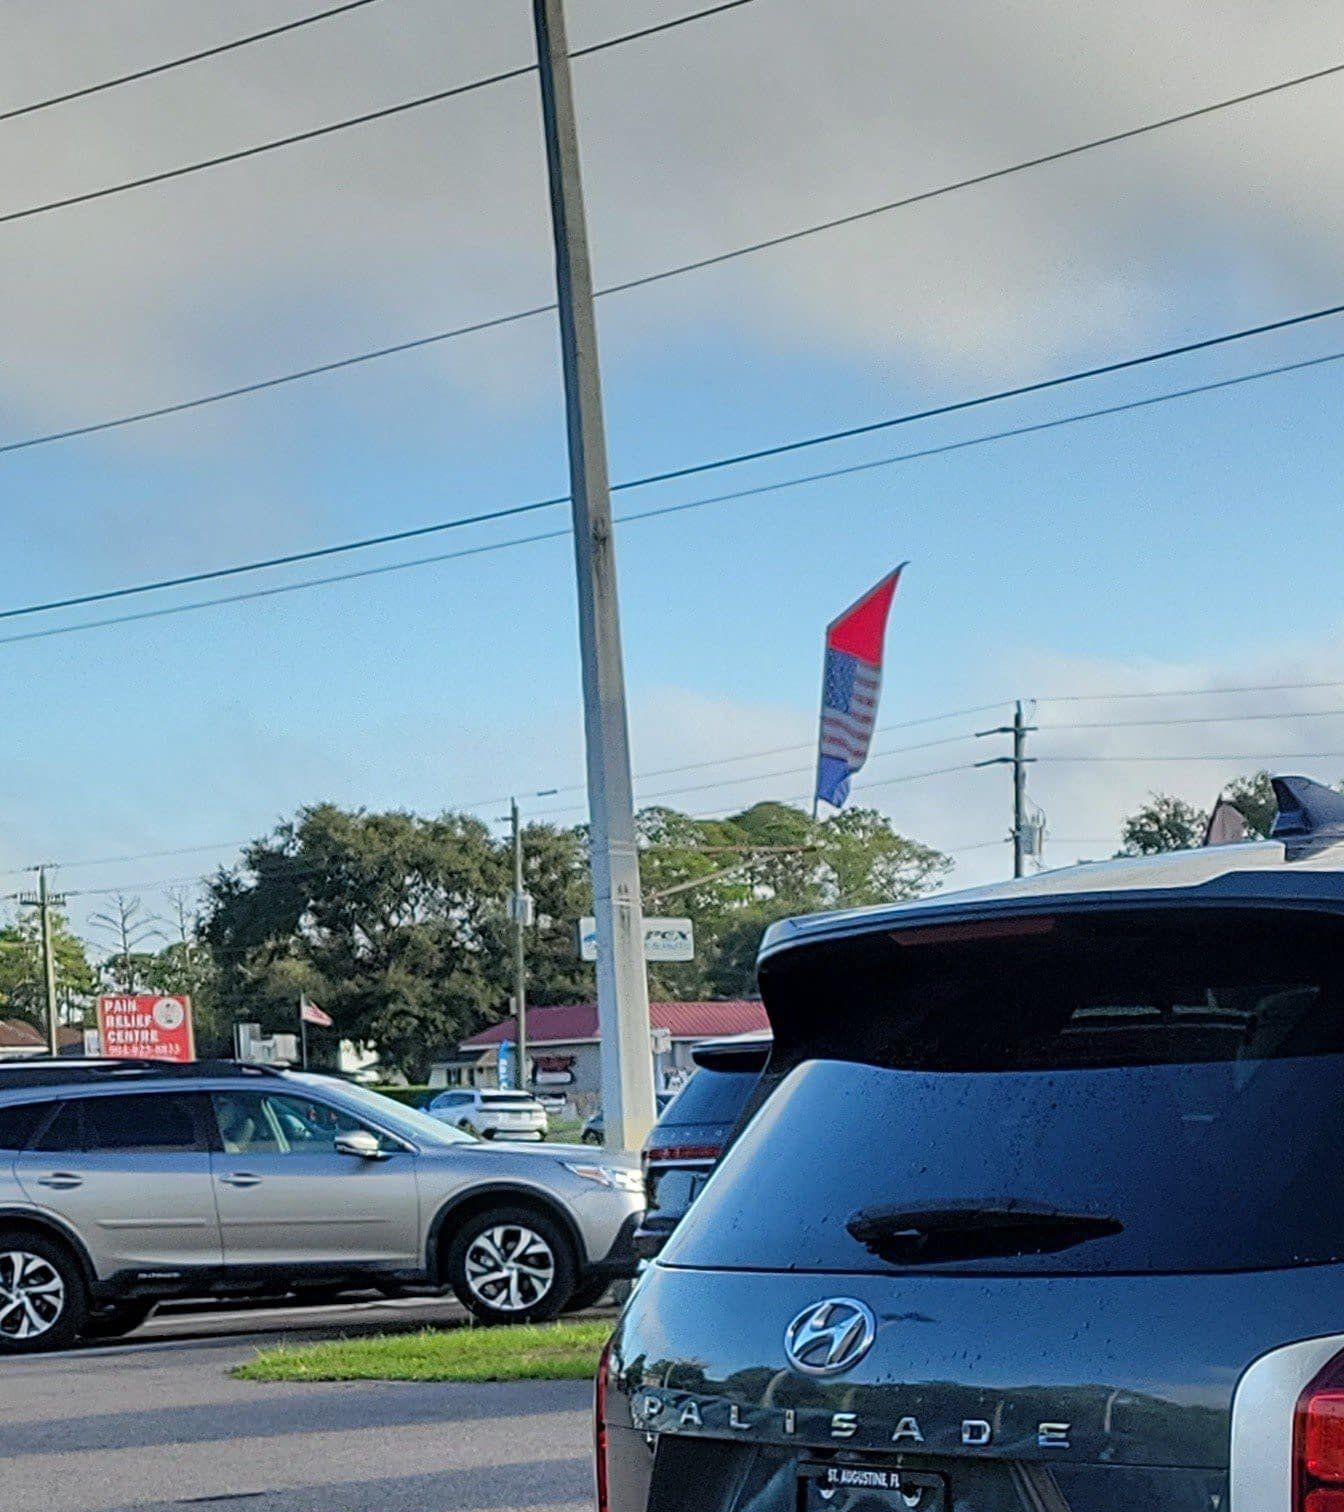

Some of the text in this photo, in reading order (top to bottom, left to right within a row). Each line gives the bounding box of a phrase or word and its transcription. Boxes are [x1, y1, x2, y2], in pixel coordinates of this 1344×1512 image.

[104, 999, 137, 1012] PAIN
[105, 1014, 152, 1028] RELIEF
[107, 1029, 159, 1043] CENTRE
[643, 1396, 1072, 1449] PALISADE
[890, 1474, 900, 1488] FL
